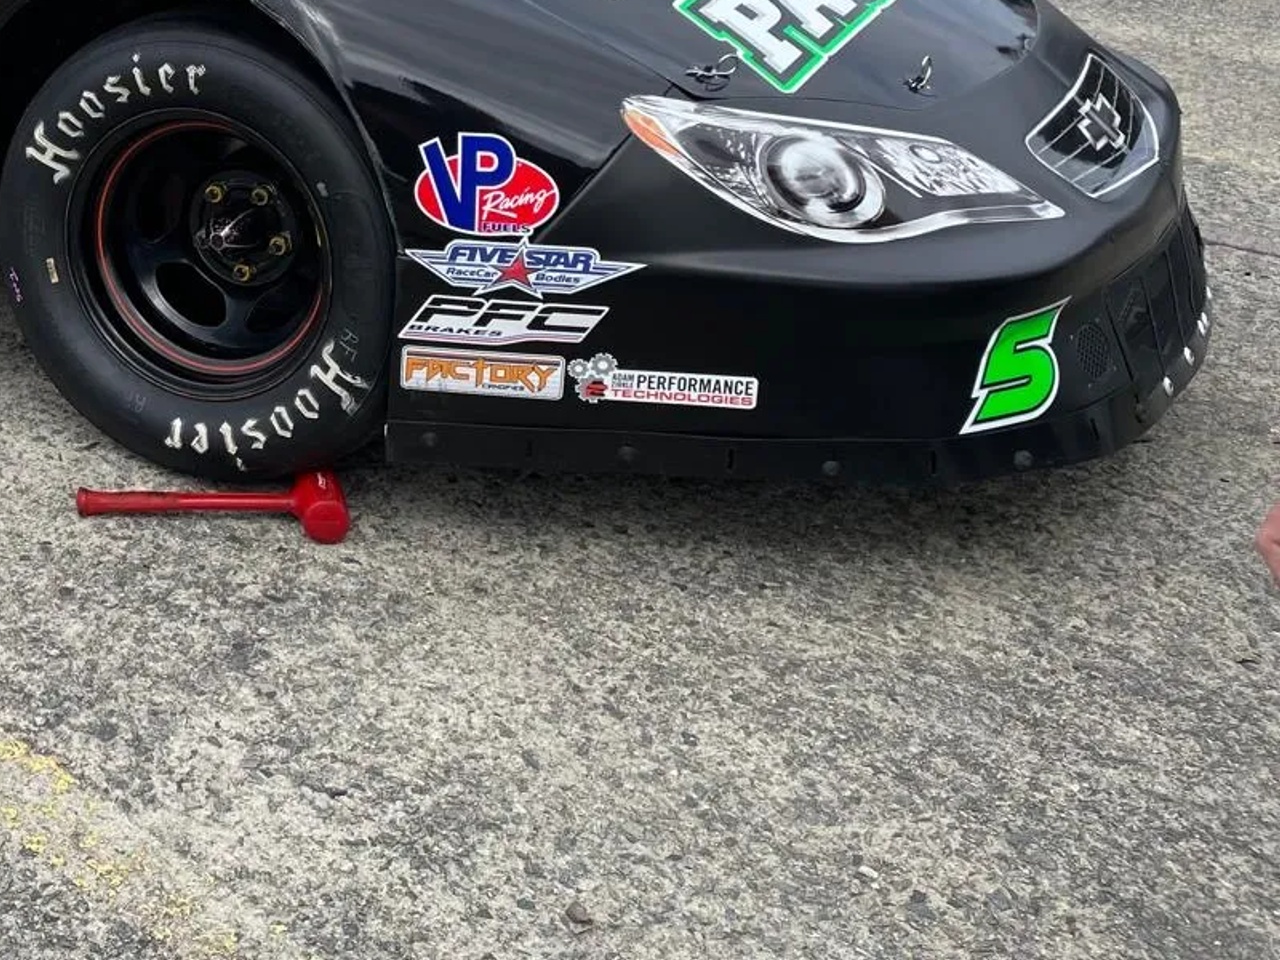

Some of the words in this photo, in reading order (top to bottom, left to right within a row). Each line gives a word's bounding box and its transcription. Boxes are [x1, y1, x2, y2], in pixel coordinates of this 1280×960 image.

[25, 53, 207, 185] Hoosier
[420, 133, 515, 232] VP
[483, 187, 550, 221] Racing
[482, 222, 532, 233] FUELS
[448, 246, 517, 265] FIVE
[524, 249, 596, 273] STAR
[534, 272, 582, 285] Bodies
[409, 323, 503, 338] BRAKES
[410, 300, 603, 333] PFC
[406, 356, 558, 393] FACTORY
[964, 300, 1067, 430] 5
[612, 388, 753, 406] TECHNOLOGIES
[636, 374, 754, 397] PERFORMANCE
[164, 340, 375, 472] Hoosier
